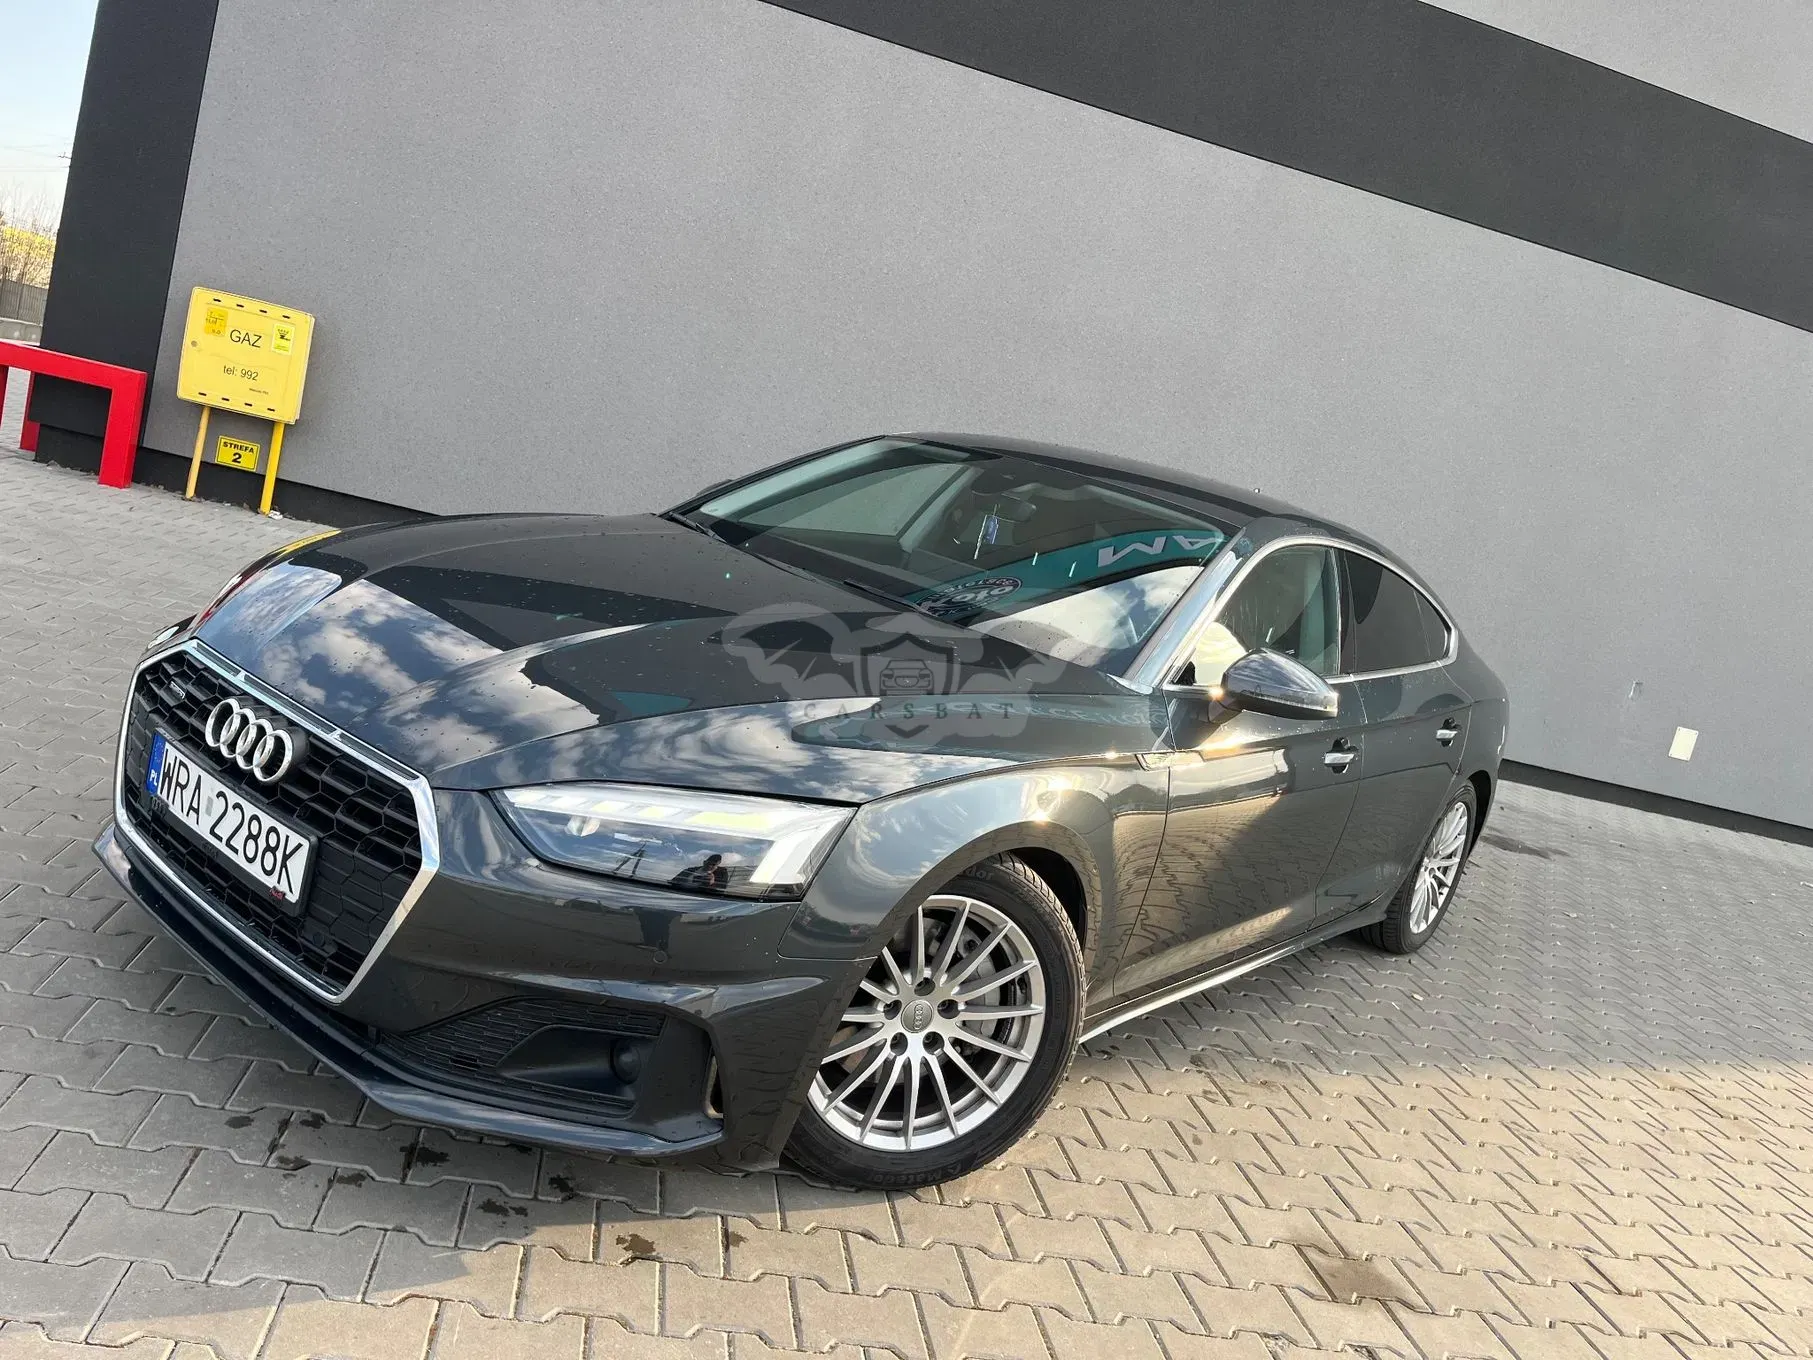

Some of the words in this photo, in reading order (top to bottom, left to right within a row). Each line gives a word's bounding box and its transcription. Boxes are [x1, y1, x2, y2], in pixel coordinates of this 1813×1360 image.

[229, 329, 262, 348] GAZ
[223, 364, 238, 377] tel:
[240, 368, 259, 381] 992
[223, 441, 255, 454] STREFA
[231, 453, 242, 464] 2
[149, 769, 158, 787] PL
[159, 748, 202, 825] WRA
[209, 790, 304, 895] 2288K
